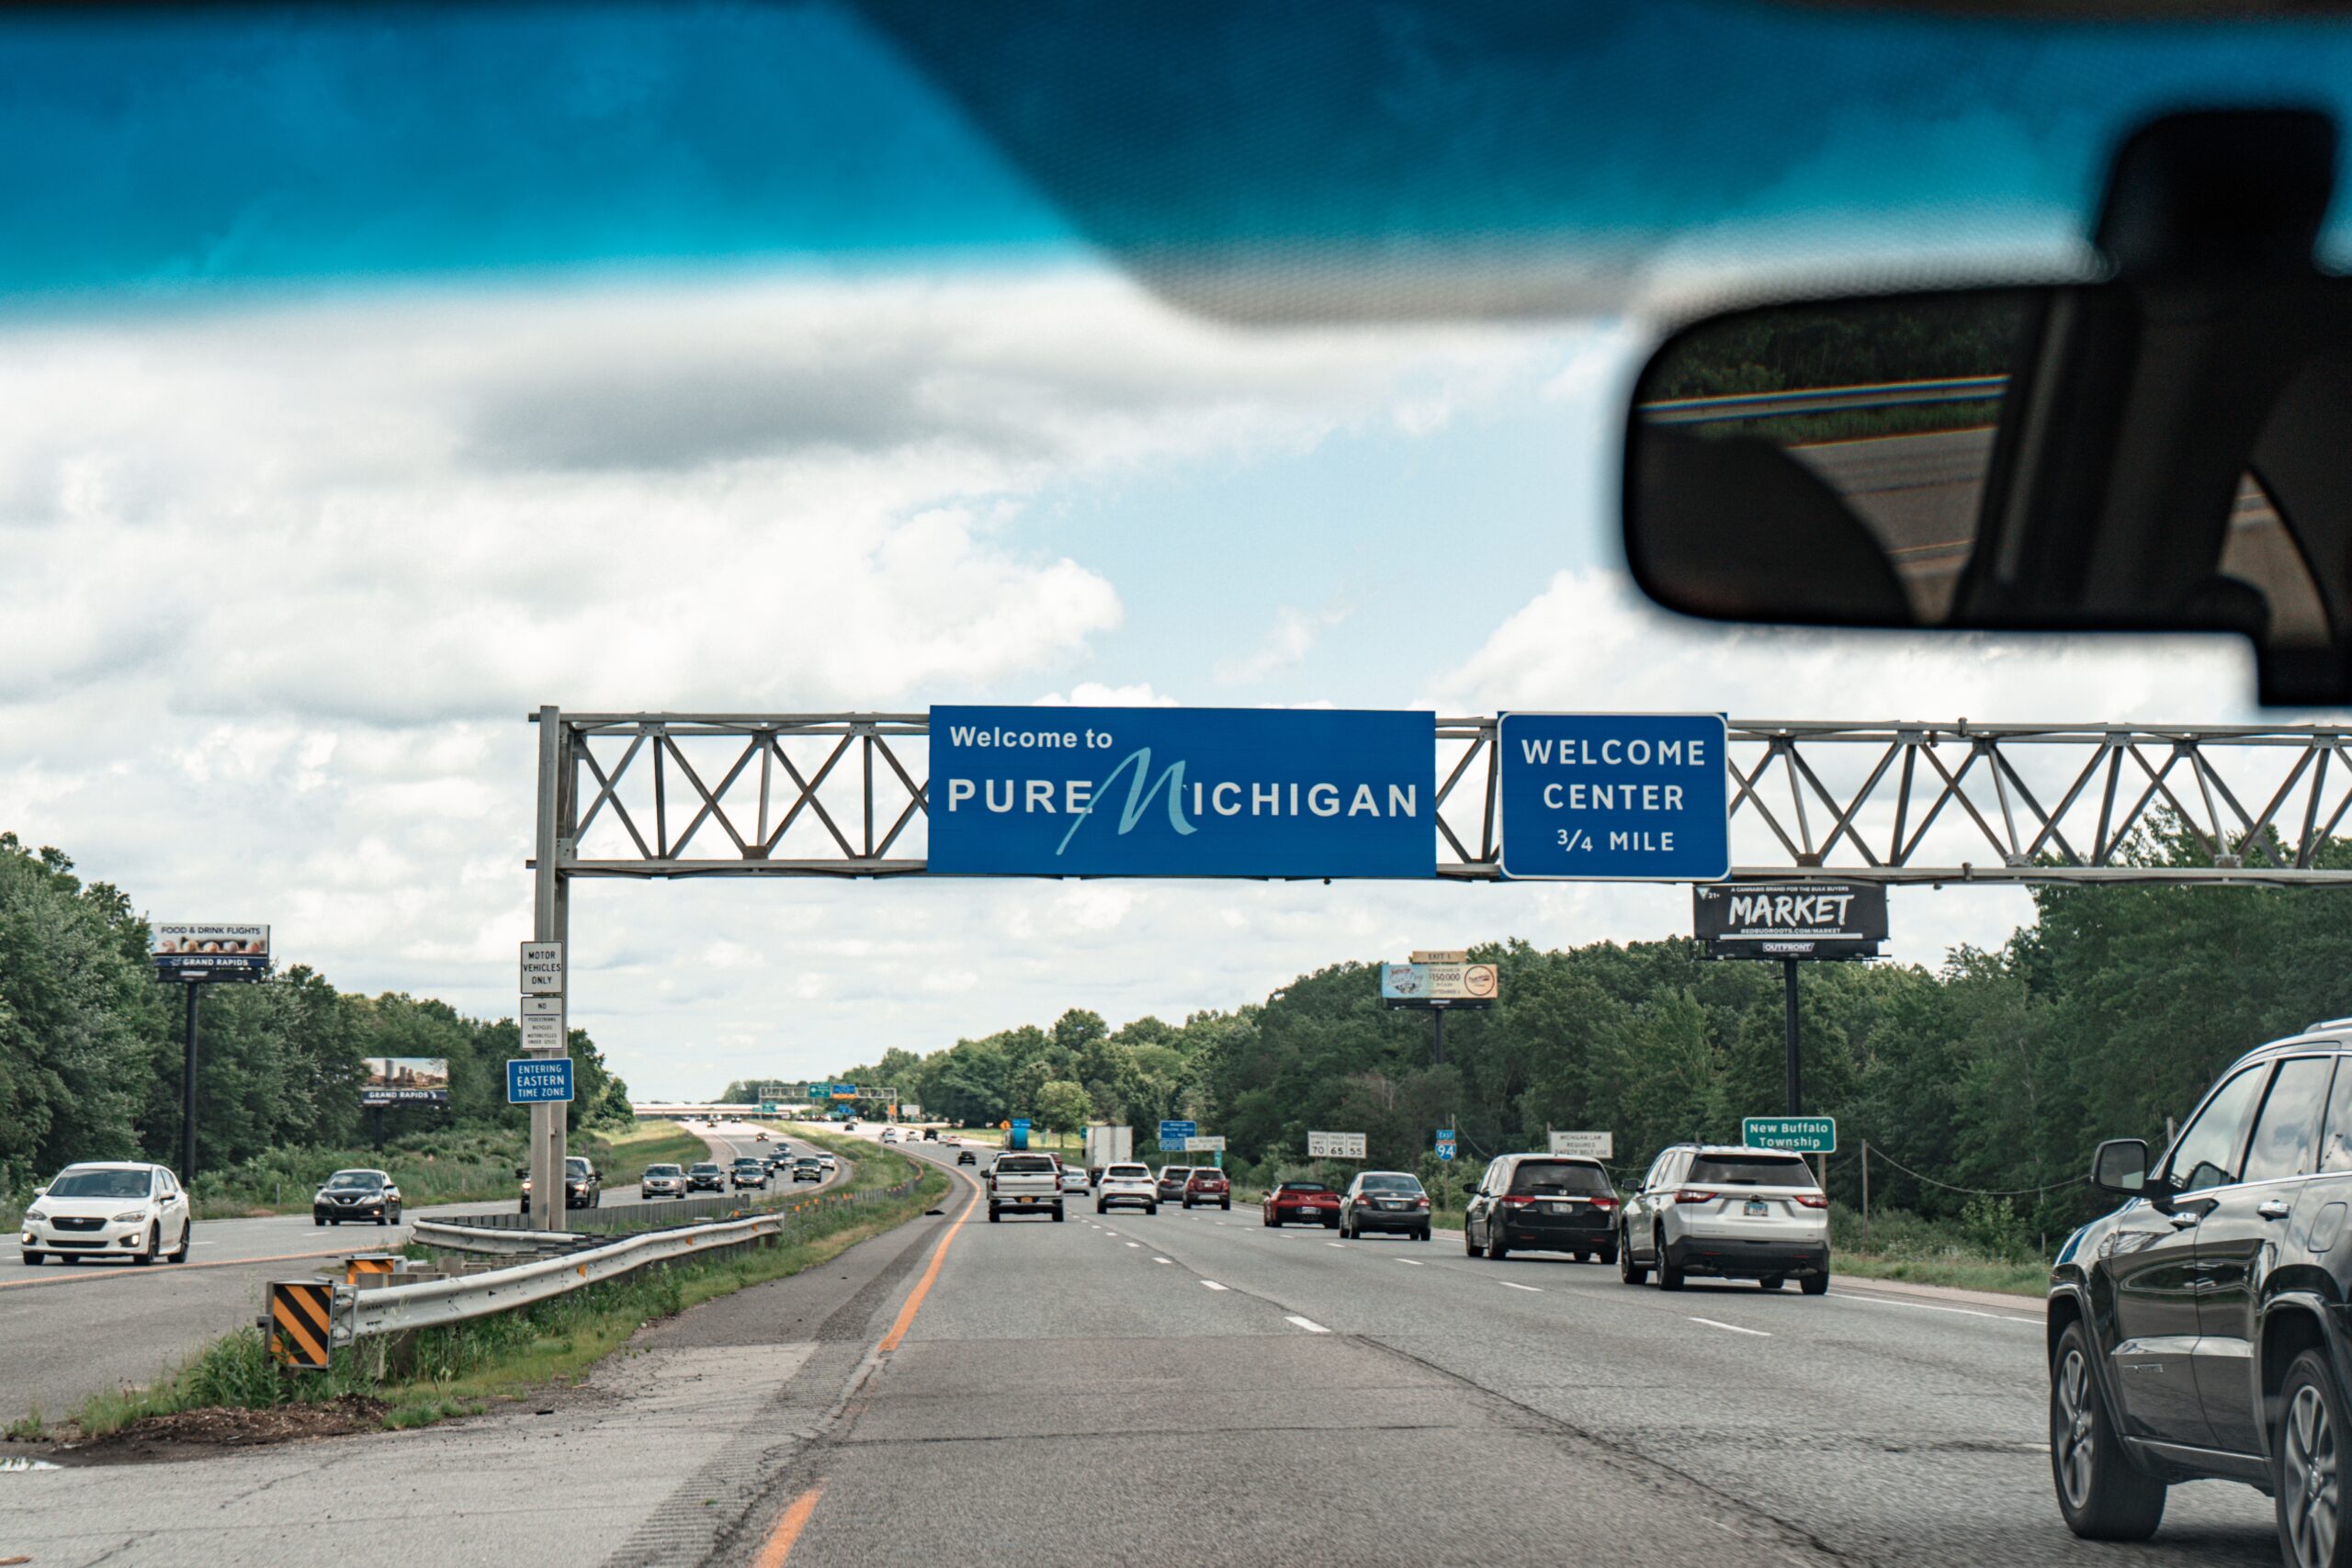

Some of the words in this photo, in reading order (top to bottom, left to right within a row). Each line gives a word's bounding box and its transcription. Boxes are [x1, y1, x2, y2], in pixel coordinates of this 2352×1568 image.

[950, 726, 1077, 749] Welcome
[1086, 728, 1113, 749] to
[1521, 739, 1705, 766] WELCOME
[948, 778, 1093, 814] PURE
[1056, 746, 1418, 856] MICHIGAN
[1544, 783, 1684, 811] CENTER
[1557, 829, 1593, 852] 3/4
[1610, 830, 1674, 852] MILE
[1728, 894, 1855, 928] MARKET
[162, 926, 187, 934] FOOD
[227, 927, 261, 935] FLIGHTS
[1765, 943, 1811, 953] OUTFRONT
[528, 951, 556, 960] MOTOR
[524, 964, 561, 972] VEHICLES
[532, 976, 552, 984] ONLY
[518, 1064, 562, 1074] ENTERING
[517, 1075, 565, 1087] EASTERN
[517, 1089, 537, 1098] TIME
[541, 1088, 565, 1097] ZONE
[1749, 1123, 1777, 1134] New
[1781, 1123, 1828, 1134] Buffalo
[1758, 1136, 1821, 1148] Township
[1312, 1145, 1324, 1154] 70
[1438, 1145, 1453, 1157] 94
